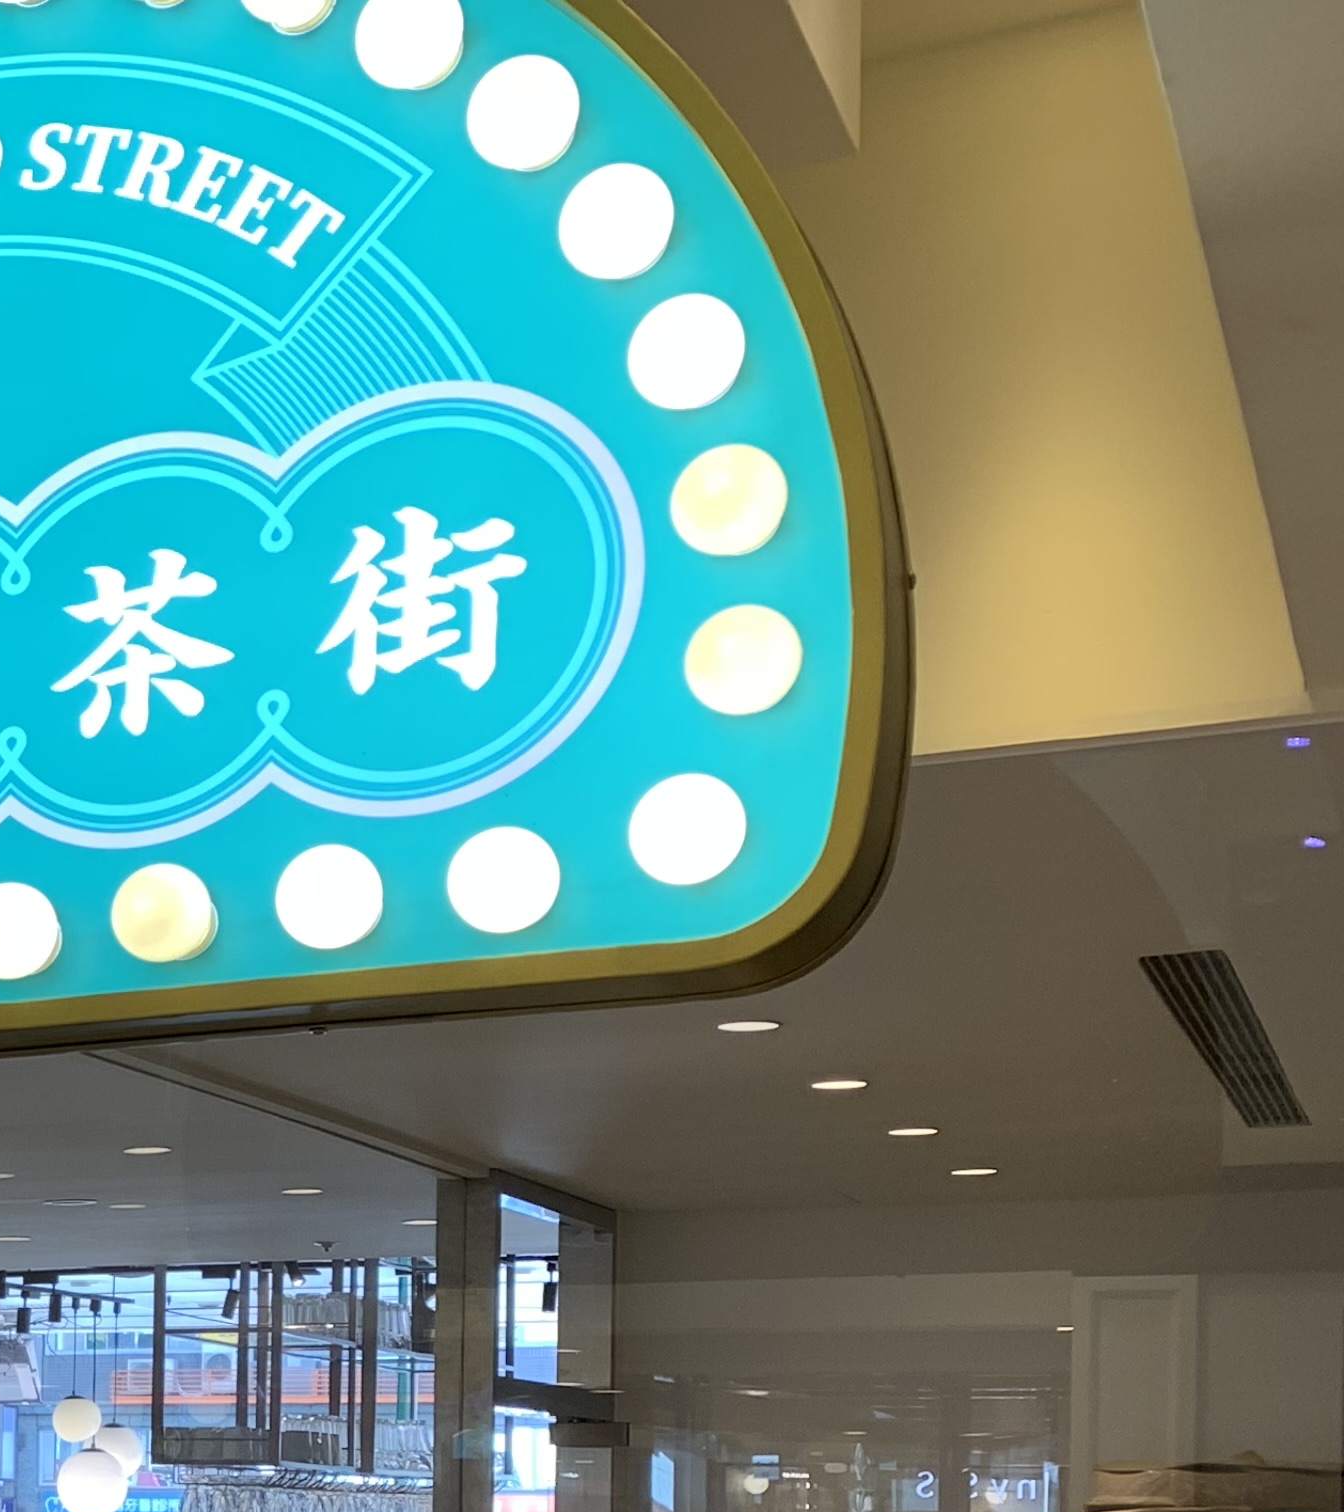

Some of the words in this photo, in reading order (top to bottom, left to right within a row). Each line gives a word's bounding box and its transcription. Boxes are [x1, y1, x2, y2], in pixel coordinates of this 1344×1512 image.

[17, 123, 346, 272] STREET
[118, 1498, 180, 1512] 牙醫診所
